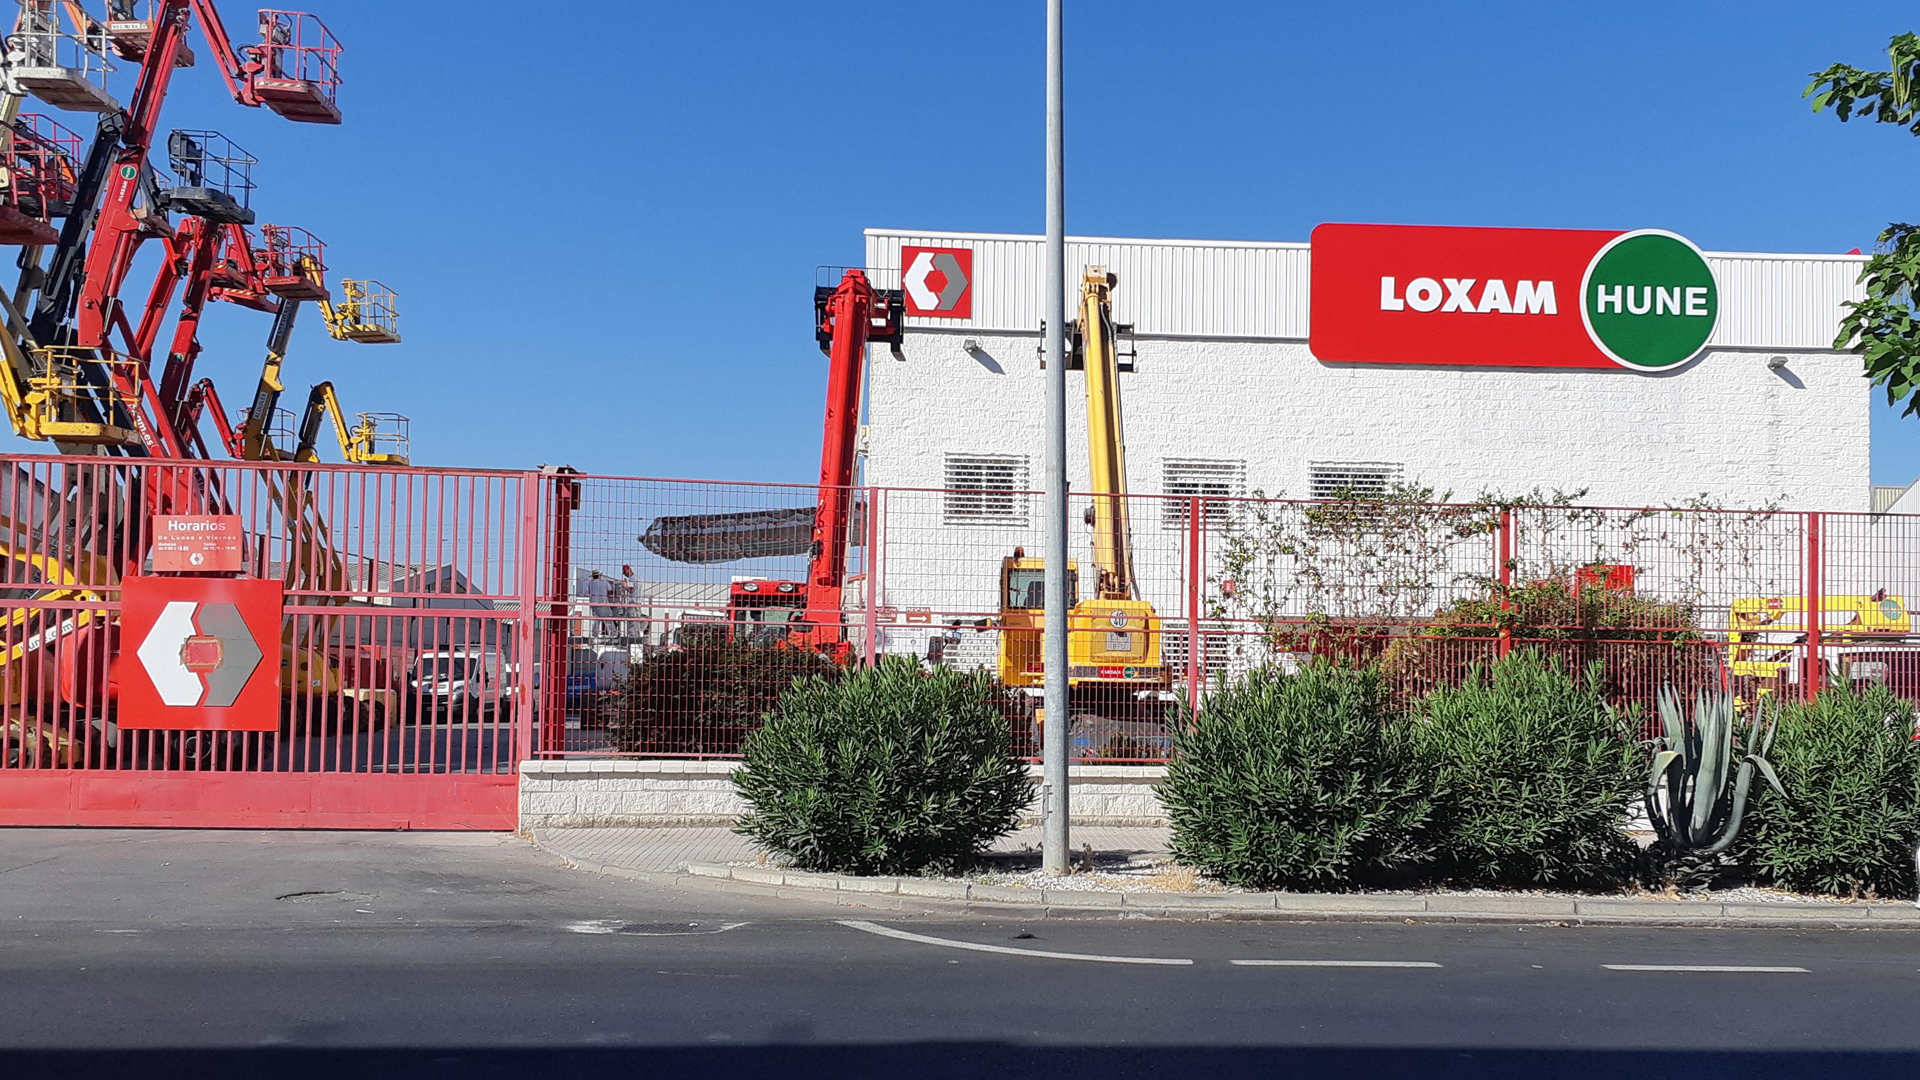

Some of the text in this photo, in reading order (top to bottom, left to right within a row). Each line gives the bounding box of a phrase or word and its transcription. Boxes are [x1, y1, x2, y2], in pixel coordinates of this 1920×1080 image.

[1380, 276, 1558, 315] LOXAM
[1597, 284, 1708, 316] HUNE
[168, 520, 226, 531] Horarios
[1113, 611, 1124, 627] 40
